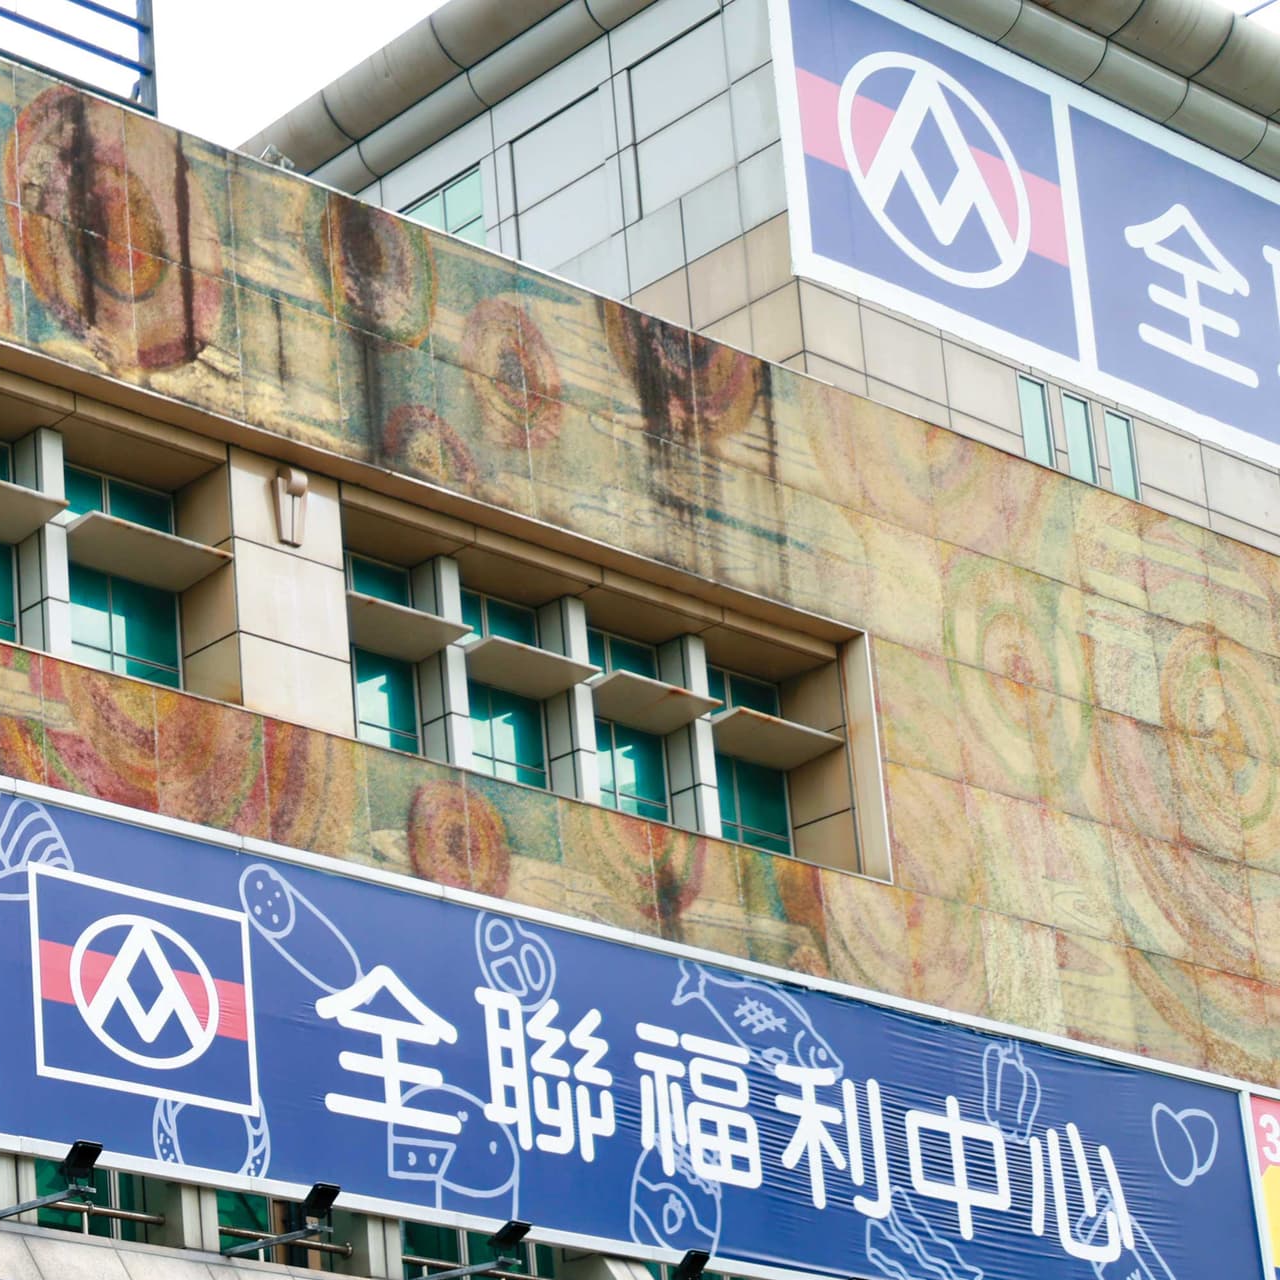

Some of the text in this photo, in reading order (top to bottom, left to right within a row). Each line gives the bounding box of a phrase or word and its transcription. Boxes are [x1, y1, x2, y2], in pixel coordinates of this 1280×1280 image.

[315, 965, 1134, 1263] 全聯福利中心
